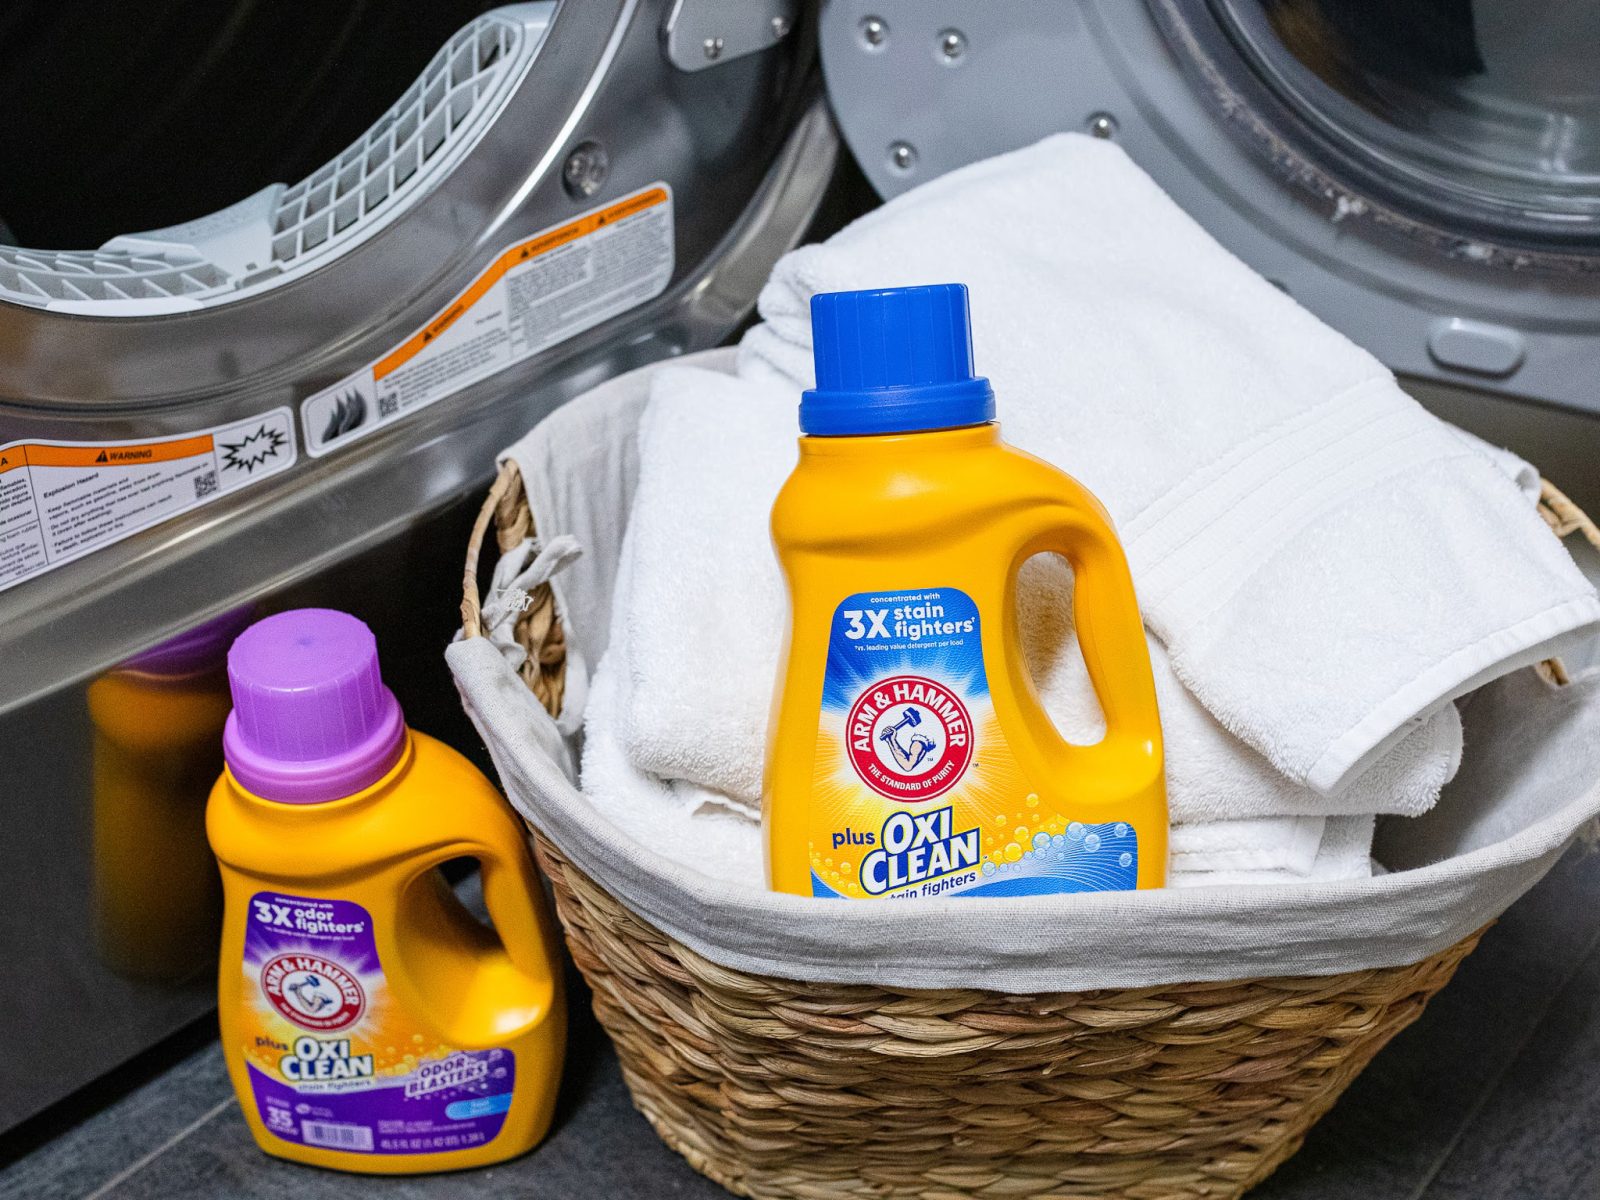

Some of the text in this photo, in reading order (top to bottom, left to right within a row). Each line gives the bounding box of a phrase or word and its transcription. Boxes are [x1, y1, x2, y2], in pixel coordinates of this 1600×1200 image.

[109, 449, 153, 460] WARNING
[870, 592, 940, 604] concentrated with
[843, 601, 945, 640] 3X stain
[867, 644, 889, 652] leading
[890, 642, 906, 650] value
[908, 641, 938, 650] detergent
[853, 683, 967, 752] ARM & HAMMER
[868, 760, 955, 790] THE STANDARD OF PURITY
[832, 806, 953, 855] plus OXI
[859, 828, 980, 895] CLEAN
[888, 872, 976, 898] tain fighters
[253, 900, 334, 928] 3X odor
[266, 958, 360, 1006] ARM & HAMMER
[256, 1036, 350, 1060] plus OXI
[280, 1054, 374, 1082] CLEAN
[409, 1062, 484, 1093] BLASTERS
[420, 1058, 466, 1078] ODOR
